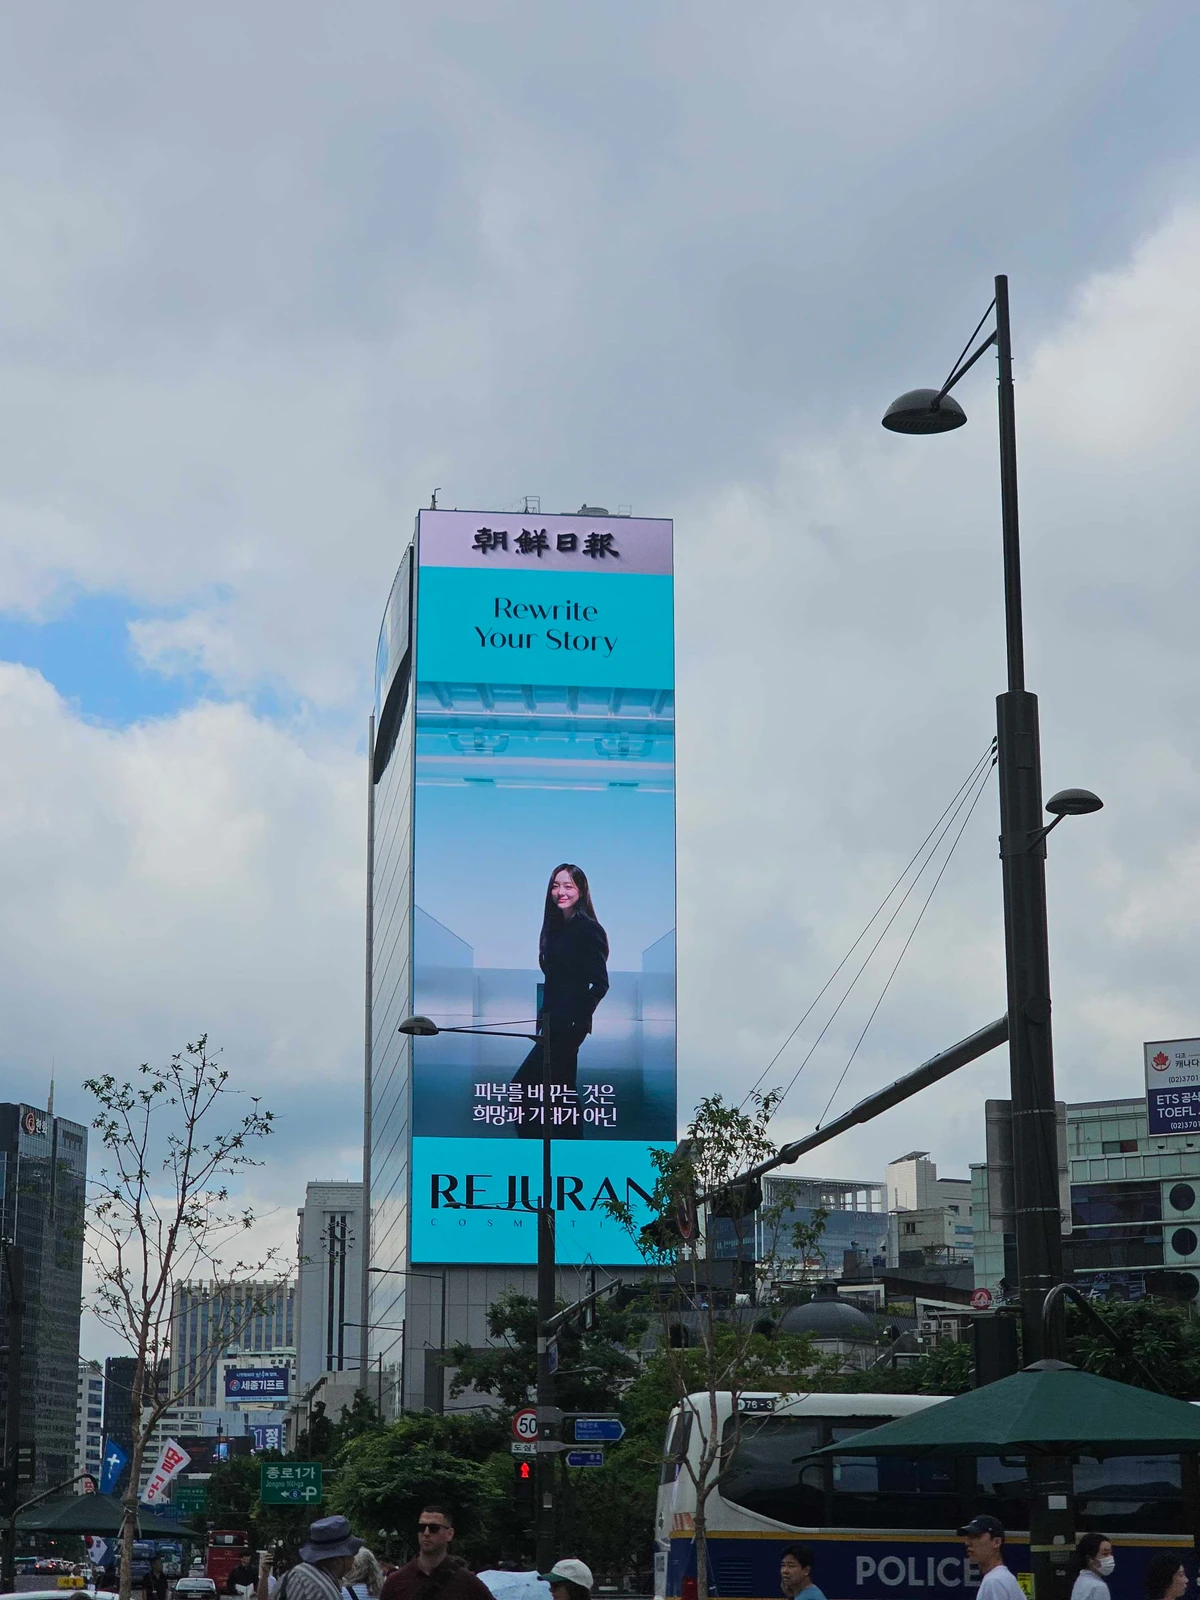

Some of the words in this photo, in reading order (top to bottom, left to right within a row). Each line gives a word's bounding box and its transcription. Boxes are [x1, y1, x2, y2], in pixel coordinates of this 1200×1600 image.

[471, 527, 620, 558] 朝鮮日報
[494, 597, 598, 622] Rewrite
[474, 626, 539, 649] Your
[545, 628, 618, 658] Story
[474, 1083, 524, 1102] 피부를
[527, 1084, 578, 1103] 바꾸는
[582, 1084, 616, 1104] 것은
[1156, 1094, 1180, 1105] ETS
[472, 1104, 525, 1126] 희망과
[583, 1107, 617, 1127] 아닌
[1157, 1106, 1196, 1118] TOEFL
[431, 1174, 660, 1211] REJURAN
[241, 1379, 285, 1391] 세종기프트
[519, 1417, 538, 1434] 50
[514, 1444, 537, 1452] 도심
[266, 1466, 316, 1479] 종로1가
[292, 1490, 298, 1498] 6
[856, 1555, 981, 1587] POLICE
